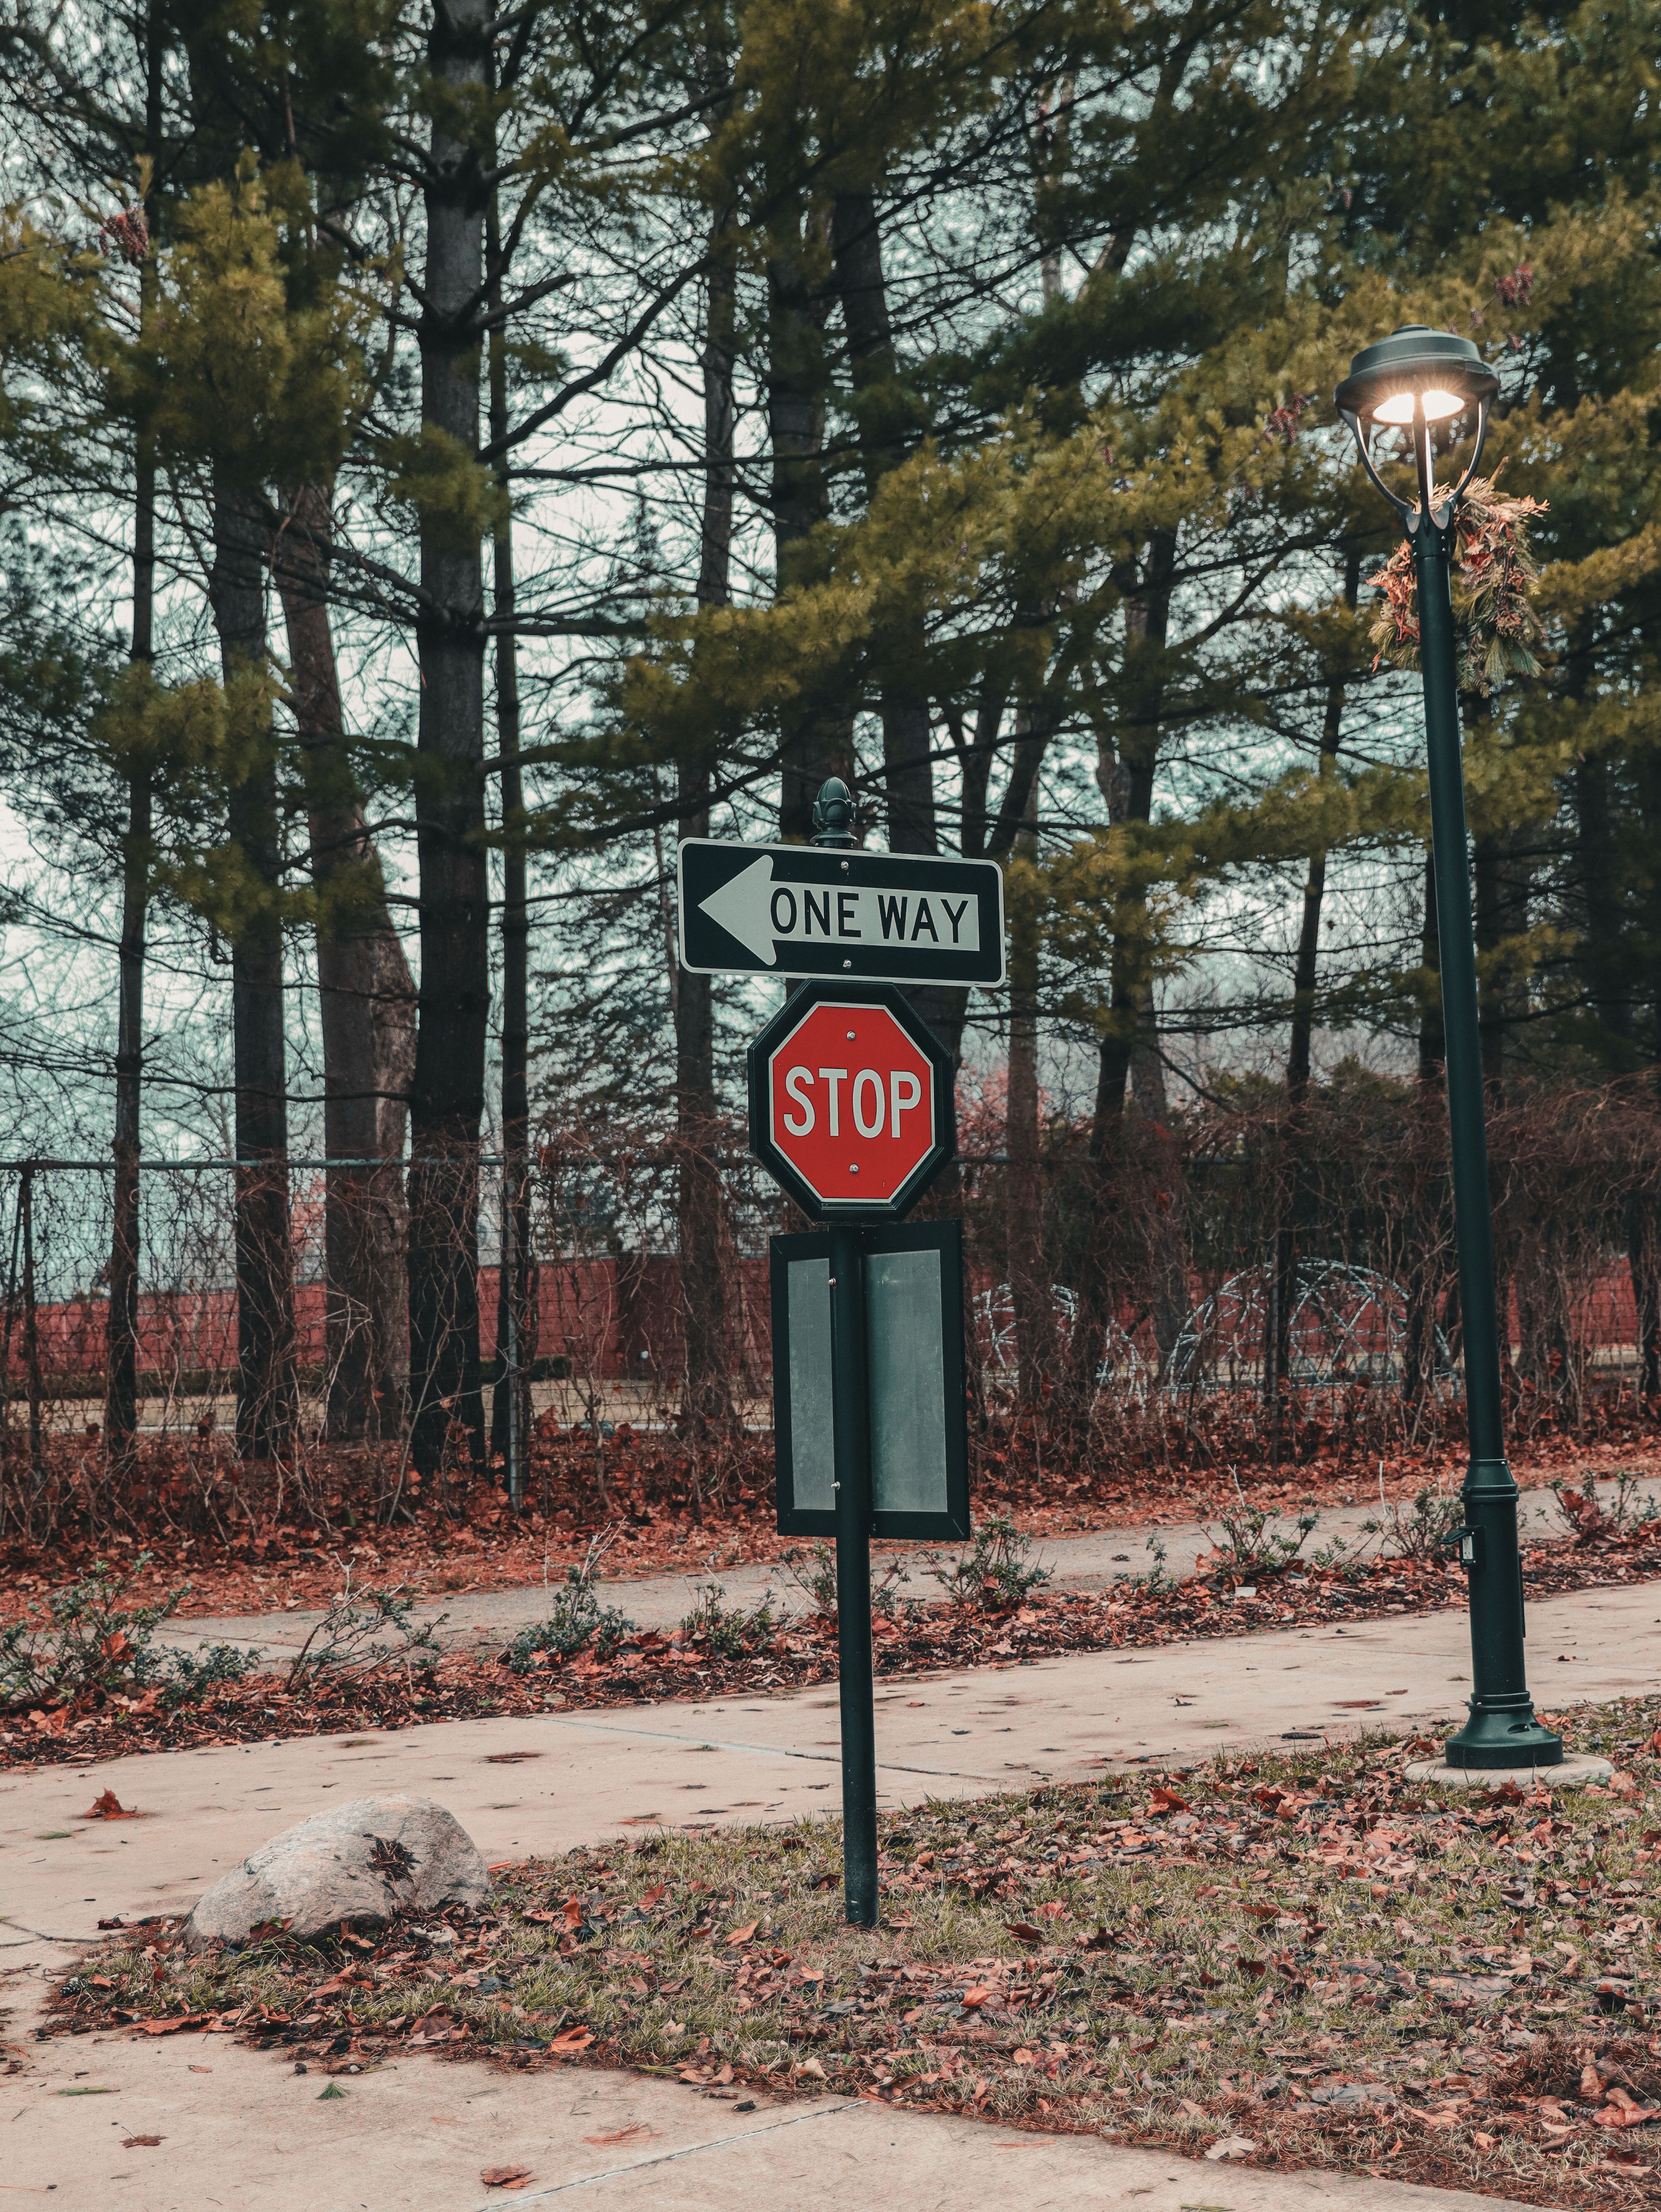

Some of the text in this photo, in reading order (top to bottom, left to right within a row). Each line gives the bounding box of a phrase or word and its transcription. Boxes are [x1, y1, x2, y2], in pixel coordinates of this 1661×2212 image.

[770, 887, 969, 944] ONE WAY
[783, 1065, 921, 1139] STOP
